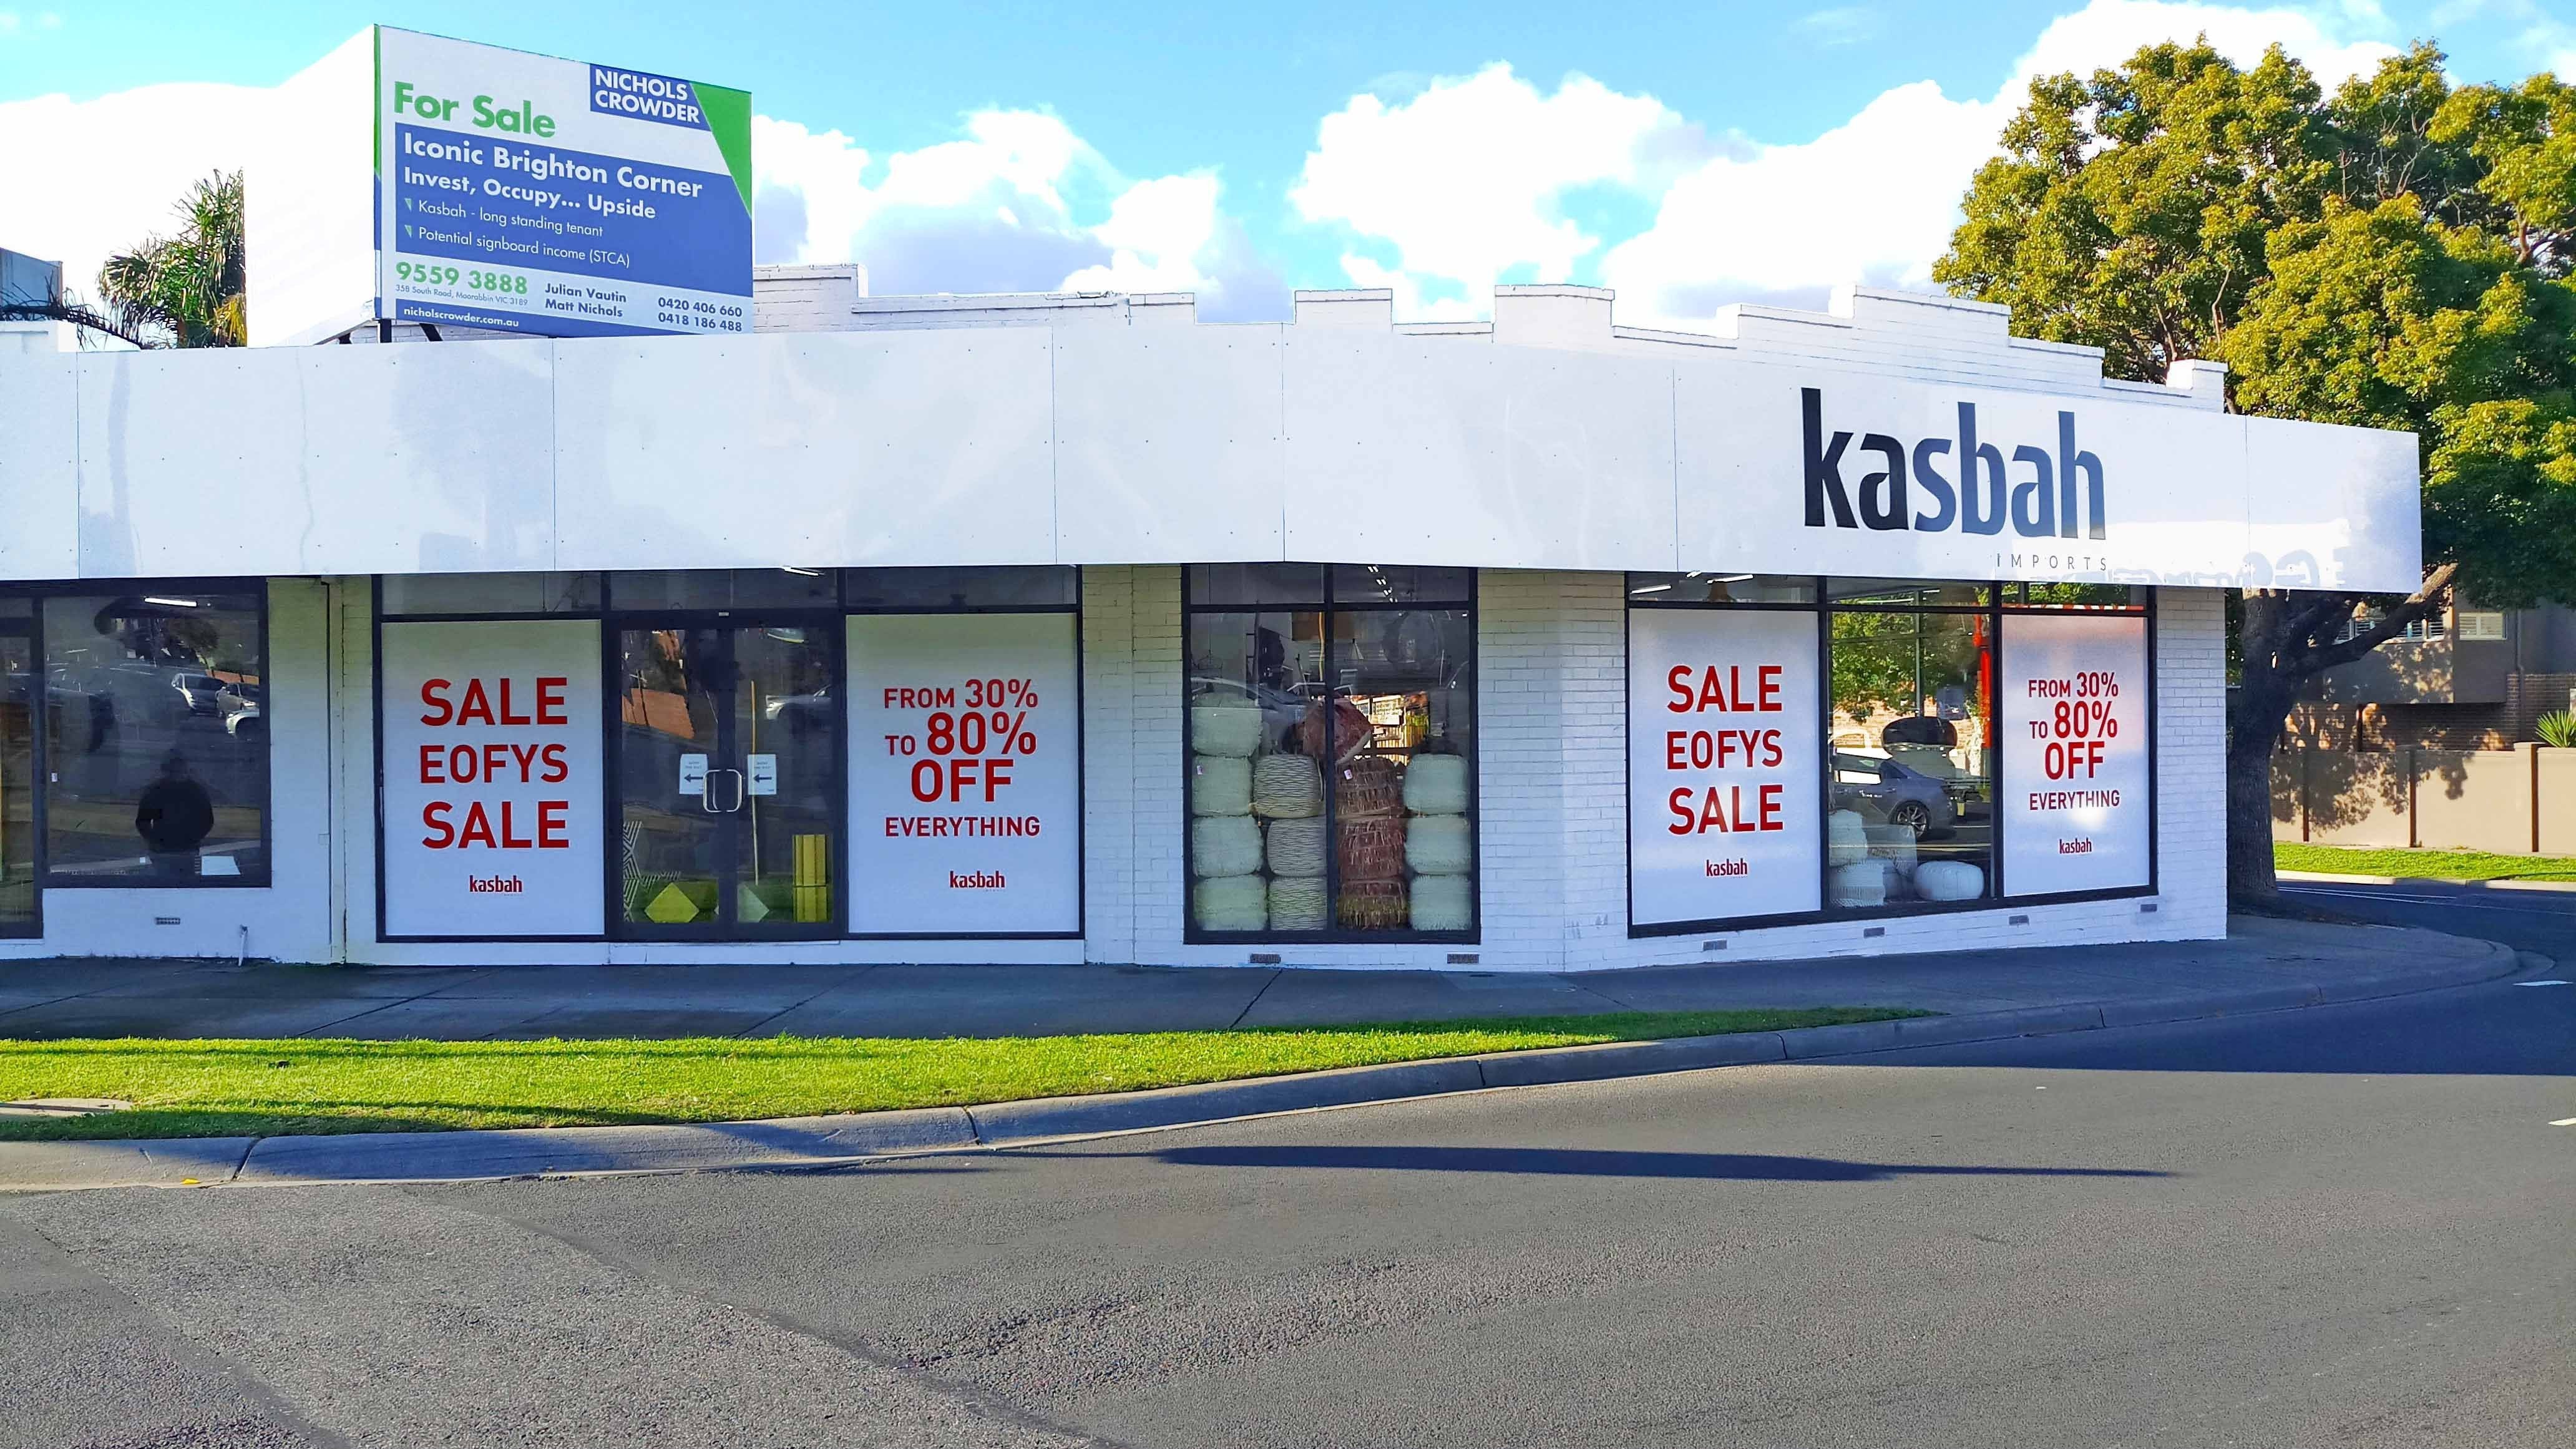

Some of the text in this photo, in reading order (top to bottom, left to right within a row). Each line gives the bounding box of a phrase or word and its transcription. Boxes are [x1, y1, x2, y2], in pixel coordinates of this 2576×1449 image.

[595, 69, 688, 100] NICHOLS
[394, 81, 556, 138] For Sale
[595, 90, 700, 124] CROWDER
[404, 132, 703, 197] Iconic Brighton Corner
[404, 167, 656, 218] Invest, Occupy... Upside
[419, 200, 466, 218] Kasbah
[480, 207, 507, 227] long
[511, 215, 562, 235] standing
[567, 222, 603, 237] tenant
[419, 227, 630, 268] Potential signboard income (STCA)
[396, 261, 528, 295] 9559 3888
[396, 284, 528, 306] 358 South Road, Moorabbin VIC 3189
[545, 283, 627, 303] Julian Vautin
[404, 306, 519, 327] nicholscrowder.com.au
[545, 298, 623, 317] Matt Nichols
[658, 297, 743, 317] 0420 406 660
[658, 312, 743, 332] 0418 186 488
[1801, 387, 2106, 540] kasbah
[1996, 553, 2107, 571] IMPORTS
[420, 677, 568, 726] SALE
[884, 679, 1038, 709] FROM 30%
[1667, 665, 1782, 713] SALE
[2029, 672, 2119, 697] FROM 30%
[885, 711, 1037, 755] TO 80%
[2029, 701, 2117, 739] TO 80%
[419, 744, 568, 784] EOFYS
[1667, 729, 1782, 769] EOFYS
[2045, 741, 2105, 780] OFF
[910, 759, 1014, 803] OFF
[1668, 784, 1783, 835] SALE
[2029, 789, 2120, 811] EVERYTHING
[422, 801, 569, 849] SALE
[885, 816, 1041, 837] EVERYTHING
[2059, 837, 2092, 854] kasbah
[469, 875, 522, 892] kasbah
[950, 871, 1005, 888] kasbah
[1706, 857, 1748, 877] kasbah
